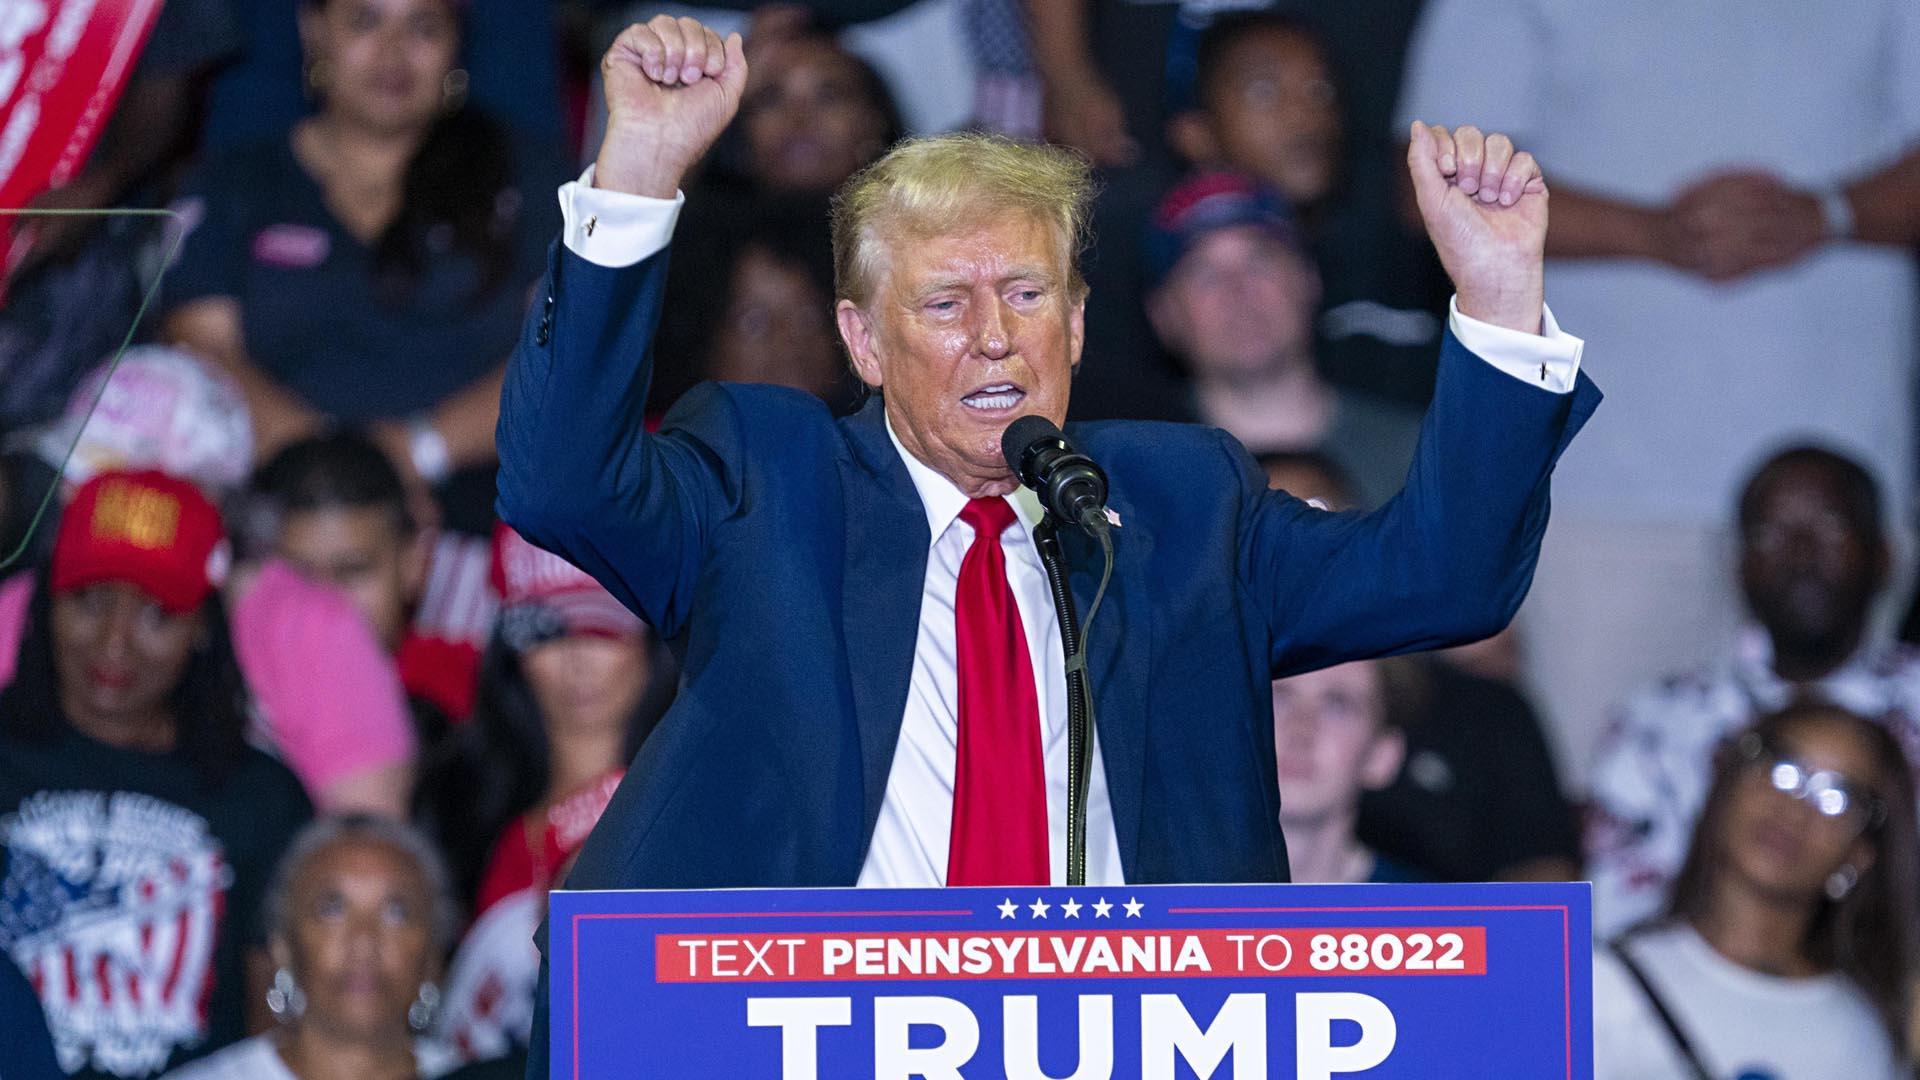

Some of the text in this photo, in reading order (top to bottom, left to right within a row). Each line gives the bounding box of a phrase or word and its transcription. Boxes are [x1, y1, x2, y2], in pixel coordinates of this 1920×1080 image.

[677, 932, 1466, 978] TEXT PENNSYLVANIA TO 88022
[746, 991, 1397, 1080] TRUMP
